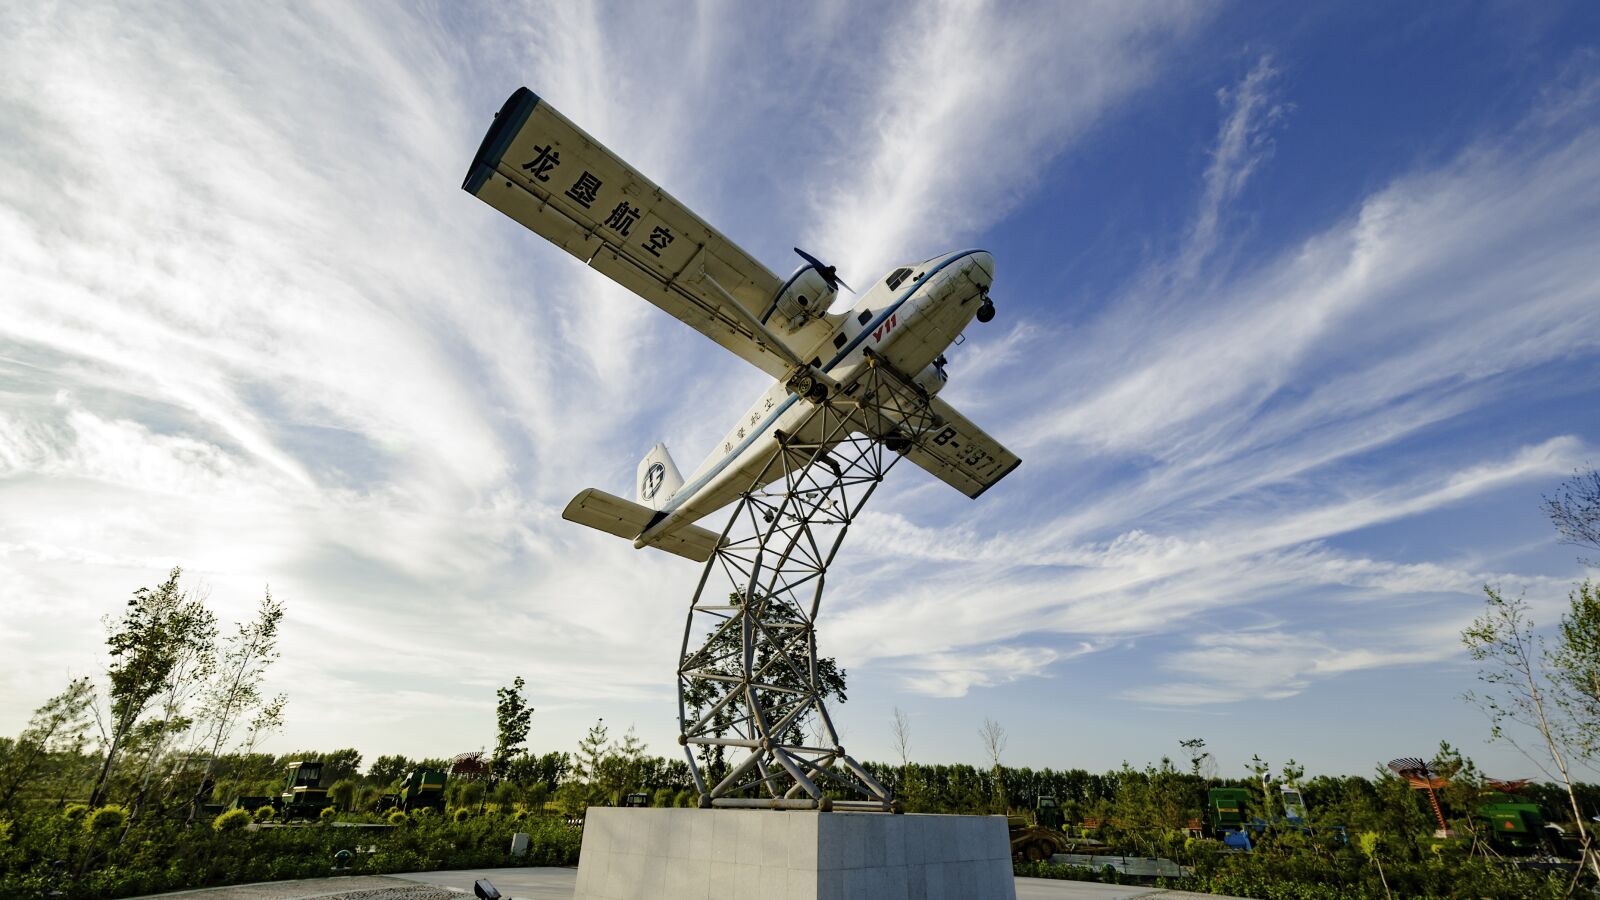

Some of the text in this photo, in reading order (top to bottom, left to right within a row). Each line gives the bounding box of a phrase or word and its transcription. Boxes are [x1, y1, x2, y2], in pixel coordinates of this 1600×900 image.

[521, 144, 675, 258] 龙垦航空
[872, 313, 897, 344] Y11
